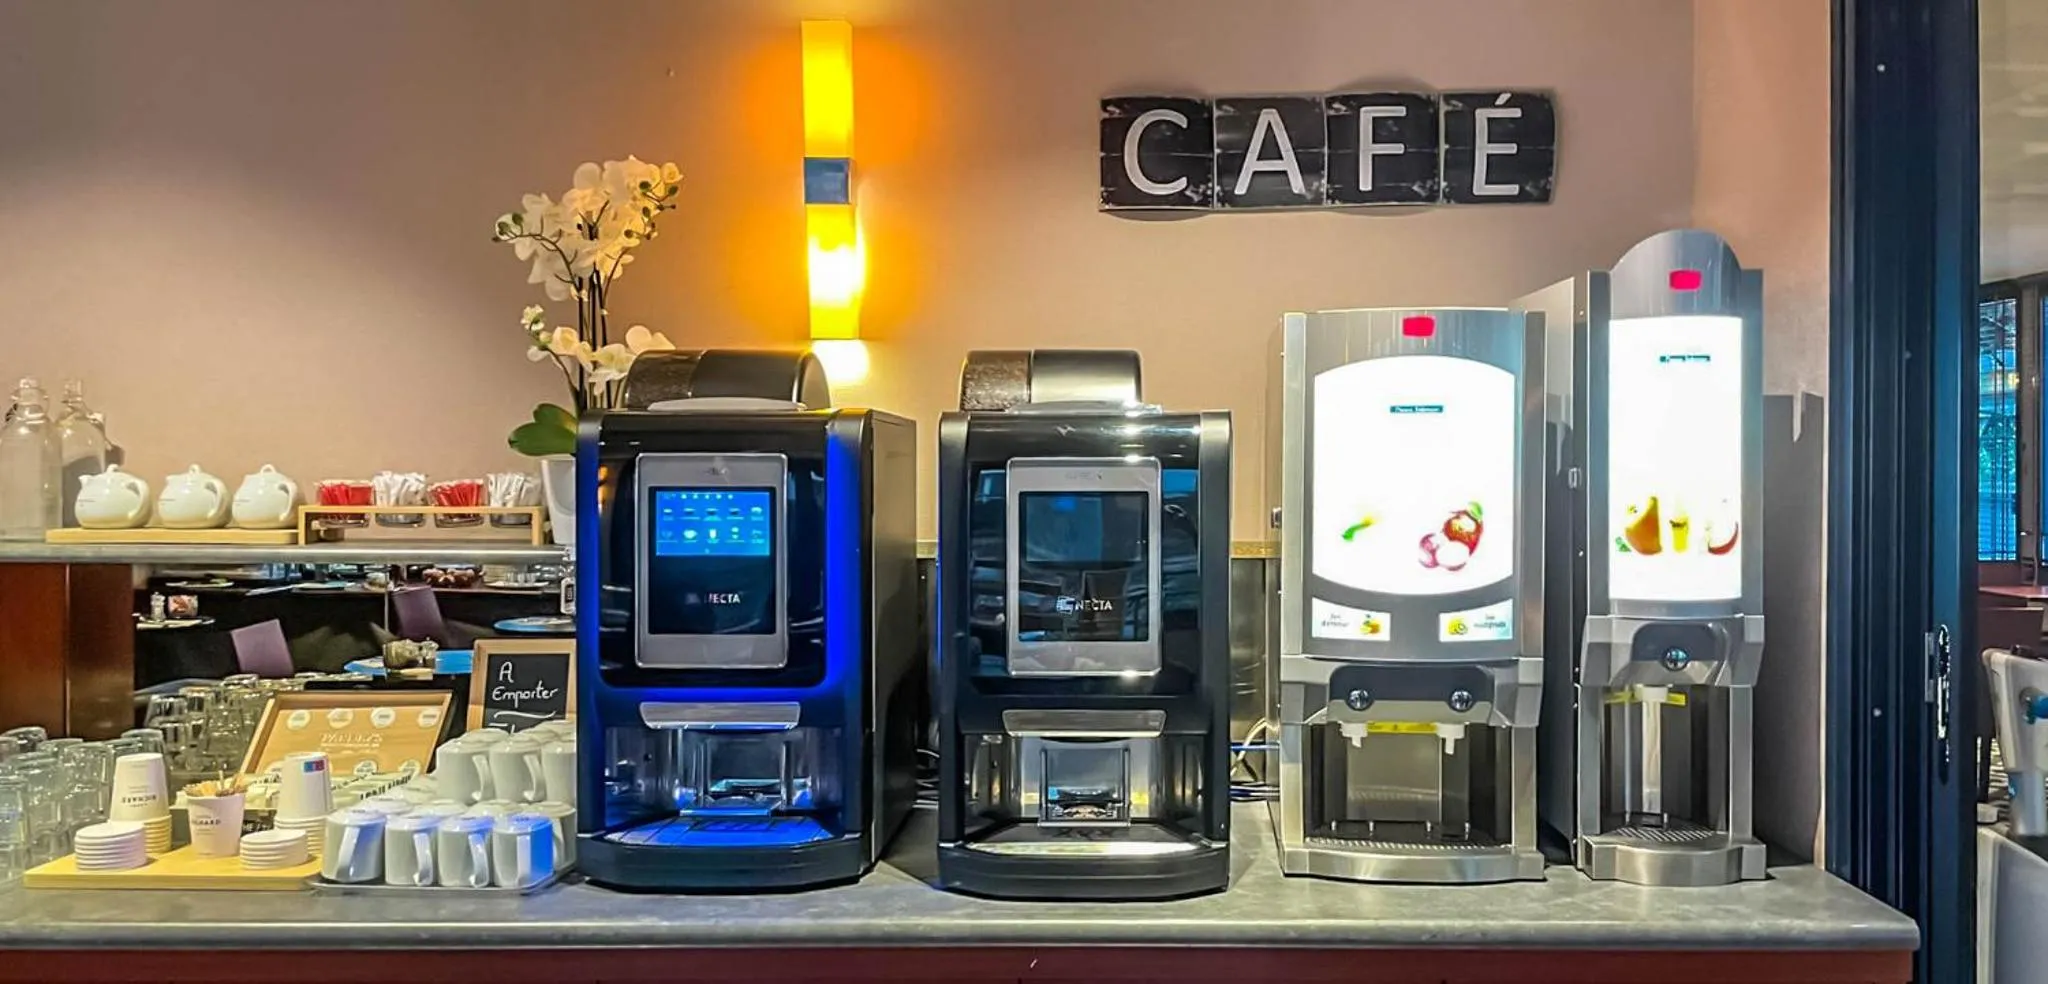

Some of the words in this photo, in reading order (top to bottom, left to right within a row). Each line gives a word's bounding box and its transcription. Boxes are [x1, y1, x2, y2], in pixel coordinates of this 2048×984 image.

[1122, 92, 1523, 196] CAFÉ
[1075, 599, 1112, 610] NECTA
[499, 661, 514, 683] A
[492, 680, 559, 709] Emporter
